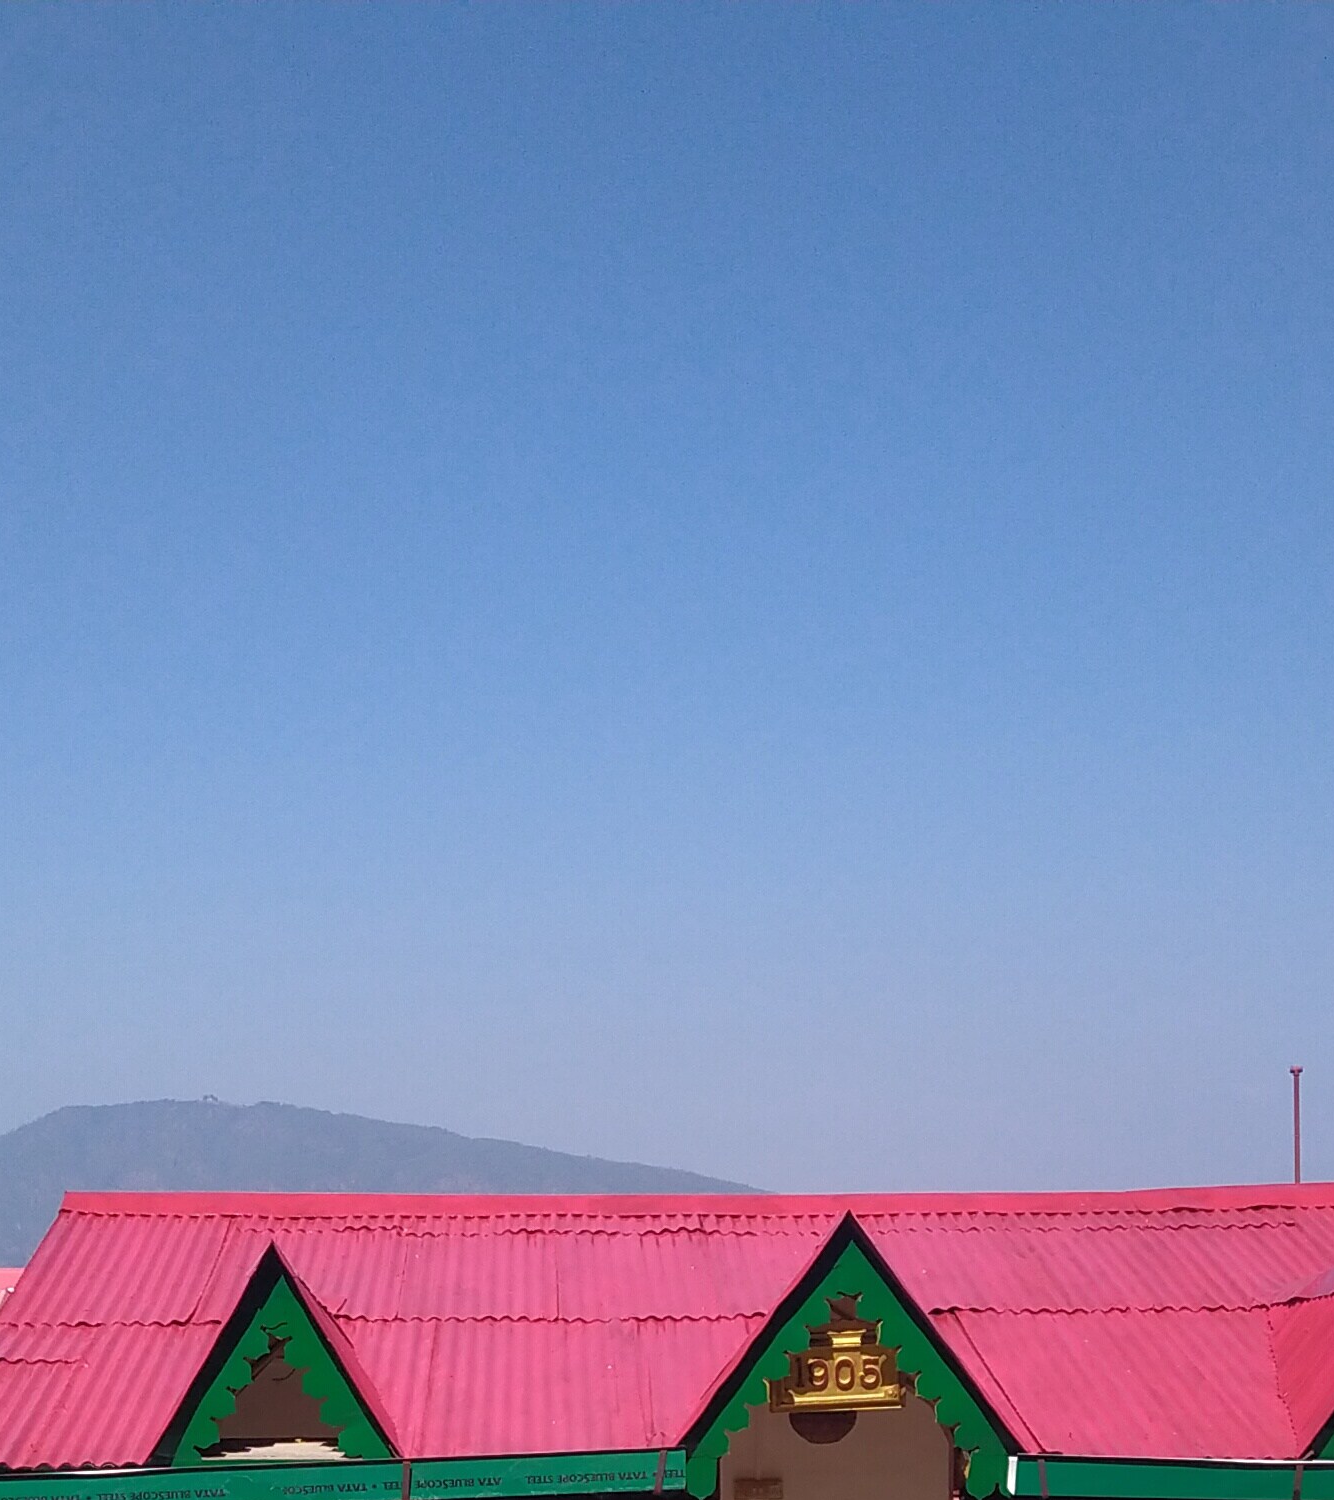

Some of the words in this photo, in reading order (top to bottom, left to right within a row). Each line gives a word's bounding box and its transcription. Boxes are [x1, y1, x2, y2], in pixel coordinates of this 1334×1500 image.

[796, 1355, 883, 1391] 1905
[525, 1475, 553, 1484] STEEL
[617, 1471, 647, 1480] TATA
[477, 1476, 502, 1486] ATA
[337, 1483, 368, 1492] TATA
[195, 1489, 226, 1498] TATA
